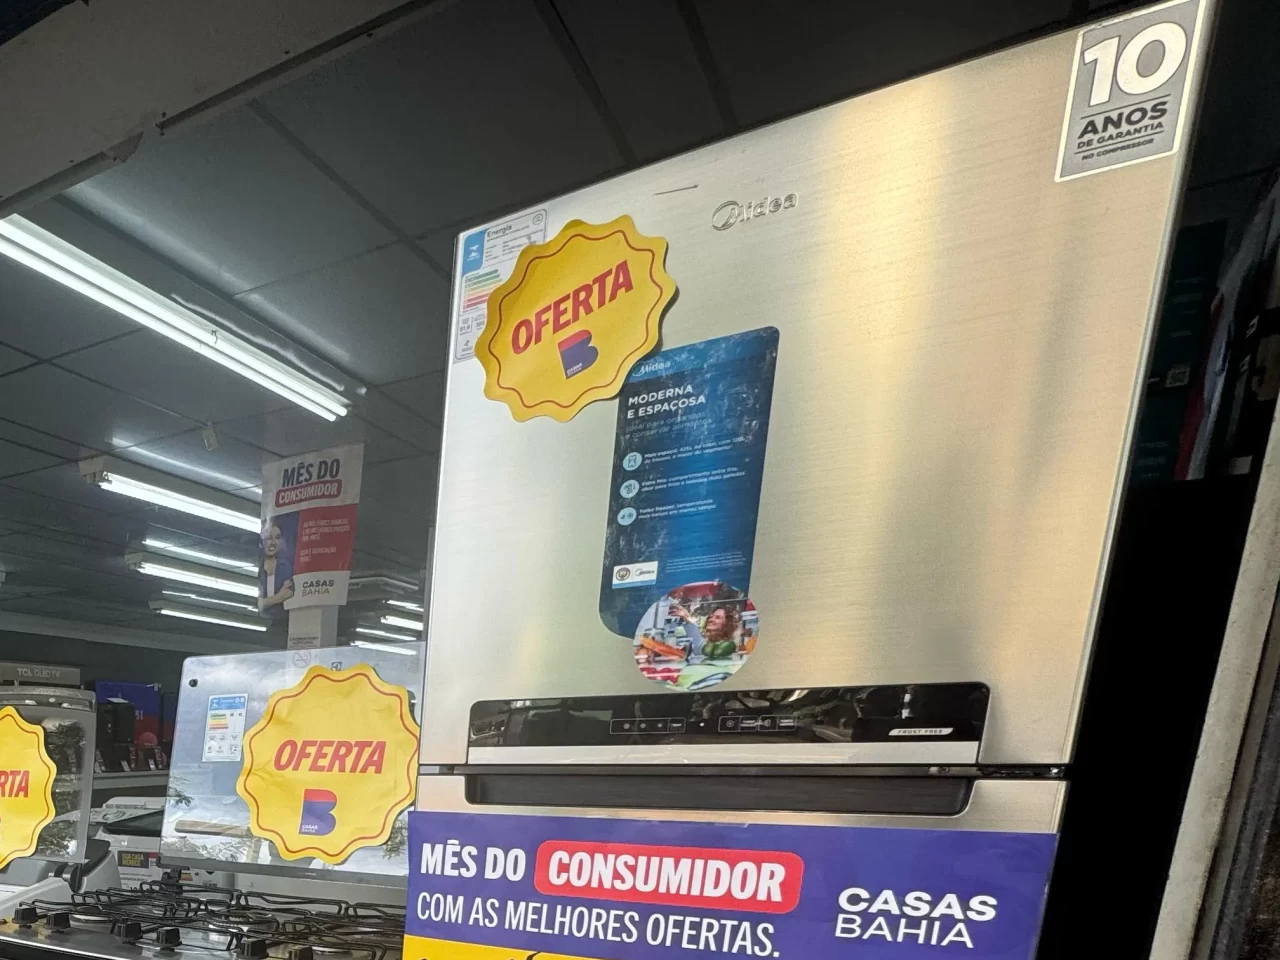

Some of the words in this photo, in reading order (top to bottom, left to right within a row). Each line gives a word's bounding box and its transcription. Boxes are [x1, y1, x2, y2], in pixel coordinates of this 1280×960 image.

[1083, 21, 1187, 107] 10
[1077, 100, 1169, 139] ANOS
[1077, 139, 1093, 149] DE
[1097, 121, 1164, 145] GARANTIA
[1082, 152, 1095, 161] NO
[1097, 138, 1155, 157] COMPRESSOR
[511, 259, 634, 355] OFERTA
[627, 409, 635, 419] E
[638, 395, 706, 417] ESPAÇOSA
[628, 384, 693, 406] MODERNA
[282, 461, 314, 488] MÊS
[317, 458, 341, 480] DO
[278, 483, 338, 504] CONSUMIDOR
[302, 580, 335, 588] CASAS
[302, 587, 330, 597] BAHIA
[17, 667, 33, 676] TCL
[273, 739, 387, 774] OFERTA
[419, 838, 478, 879] MÊS
[484, 846, 527, 882] DO
[548, 851, 785, 902] CONSUMIDOR
[838, 887, 998, 922] CASAS
[417, 892, 463, 922] COM
[469, 896, 500, 926] AS
[505, 900, 639, 942] MELHORES
[646, 916, 781, 958] OFERTAS.
[835, 913, 975, 949] BAHIA
